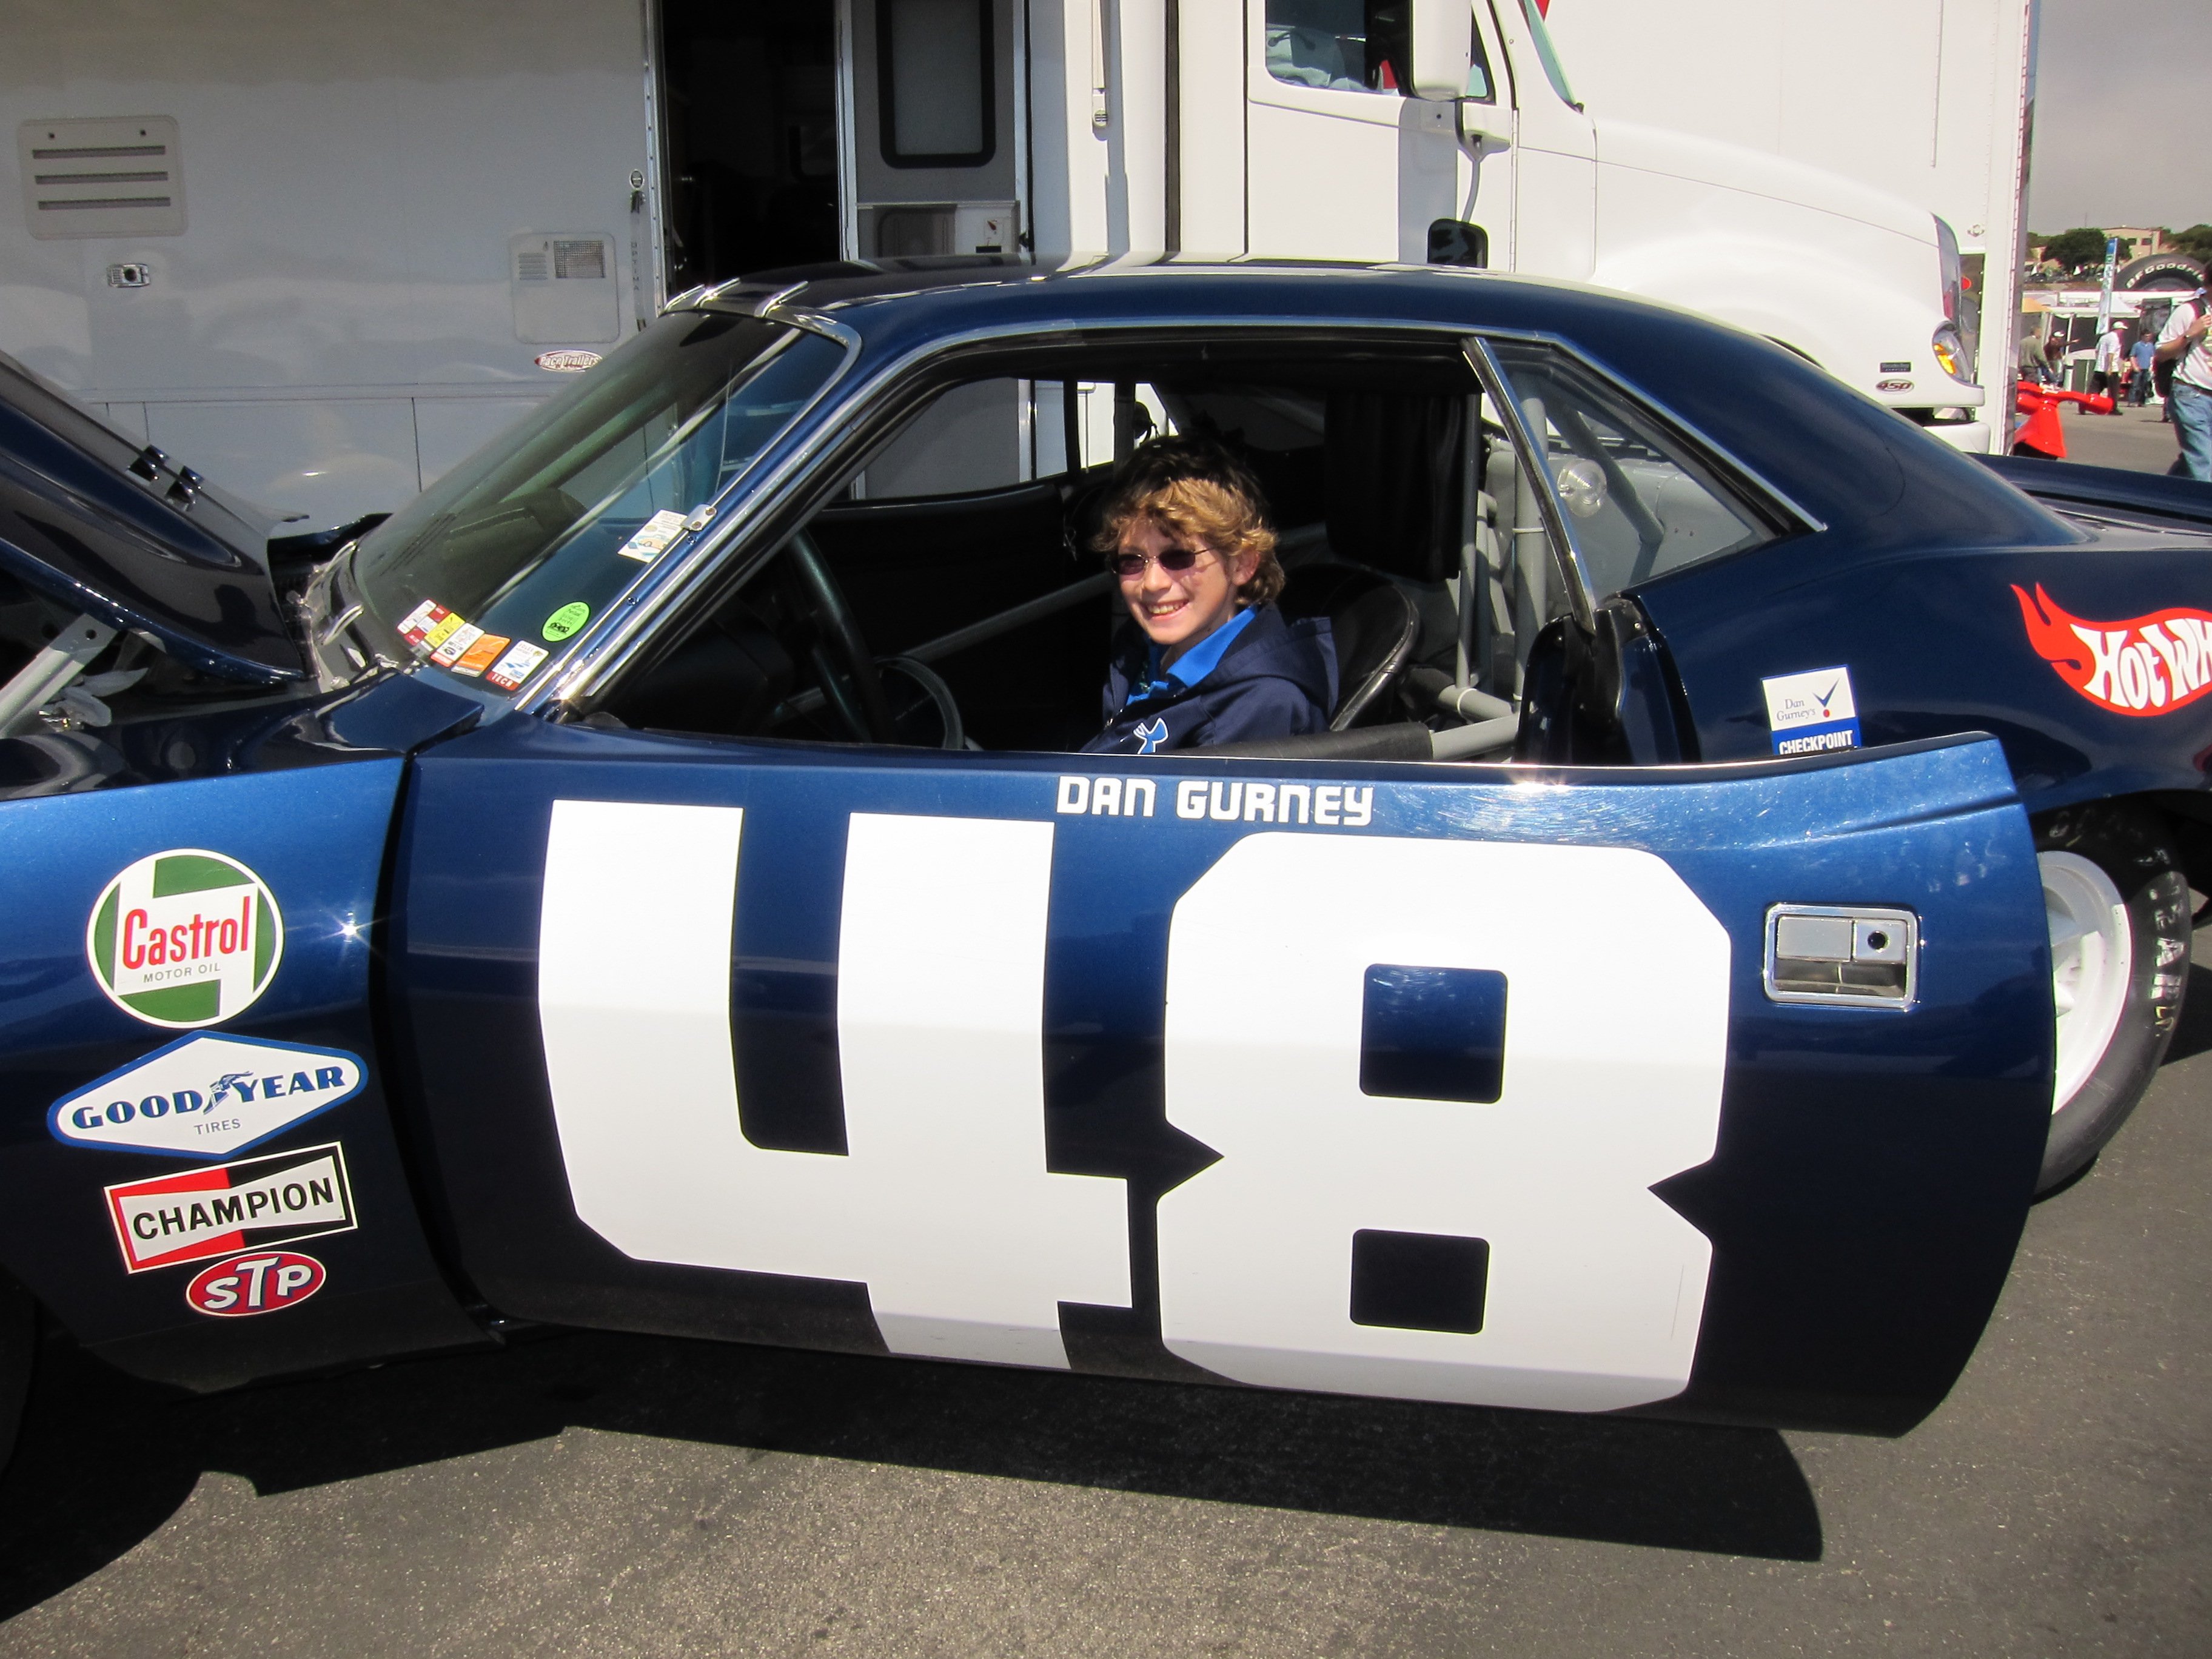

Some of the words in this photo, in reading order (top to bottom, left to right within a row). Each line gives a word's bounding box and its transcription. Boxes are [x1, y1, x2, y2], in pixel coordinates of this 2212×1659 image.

[2126, 262, 2205, 289] BFGoodric
[1776, 708, 1816, 722] Gurney's
[1785, 698, 1805, 709] Dan
[1778, 729, 1854, 755] CHECKPOINT
[1056, 776, 1157, 817] DAN
[1176, 780, 1374, 826] GURNEY
[123, 896, 250, 970] Castrol
[144, 966, 192, 983] MOTOR
[198, 962, 221, 974] OIL
[538, 800, 1731, 1412] 48
[194, 1118, 241, 1135] TIRES
[133, 1177, 335, 1240] CHAMPION
[203, 1256, 312, 1310] STP
